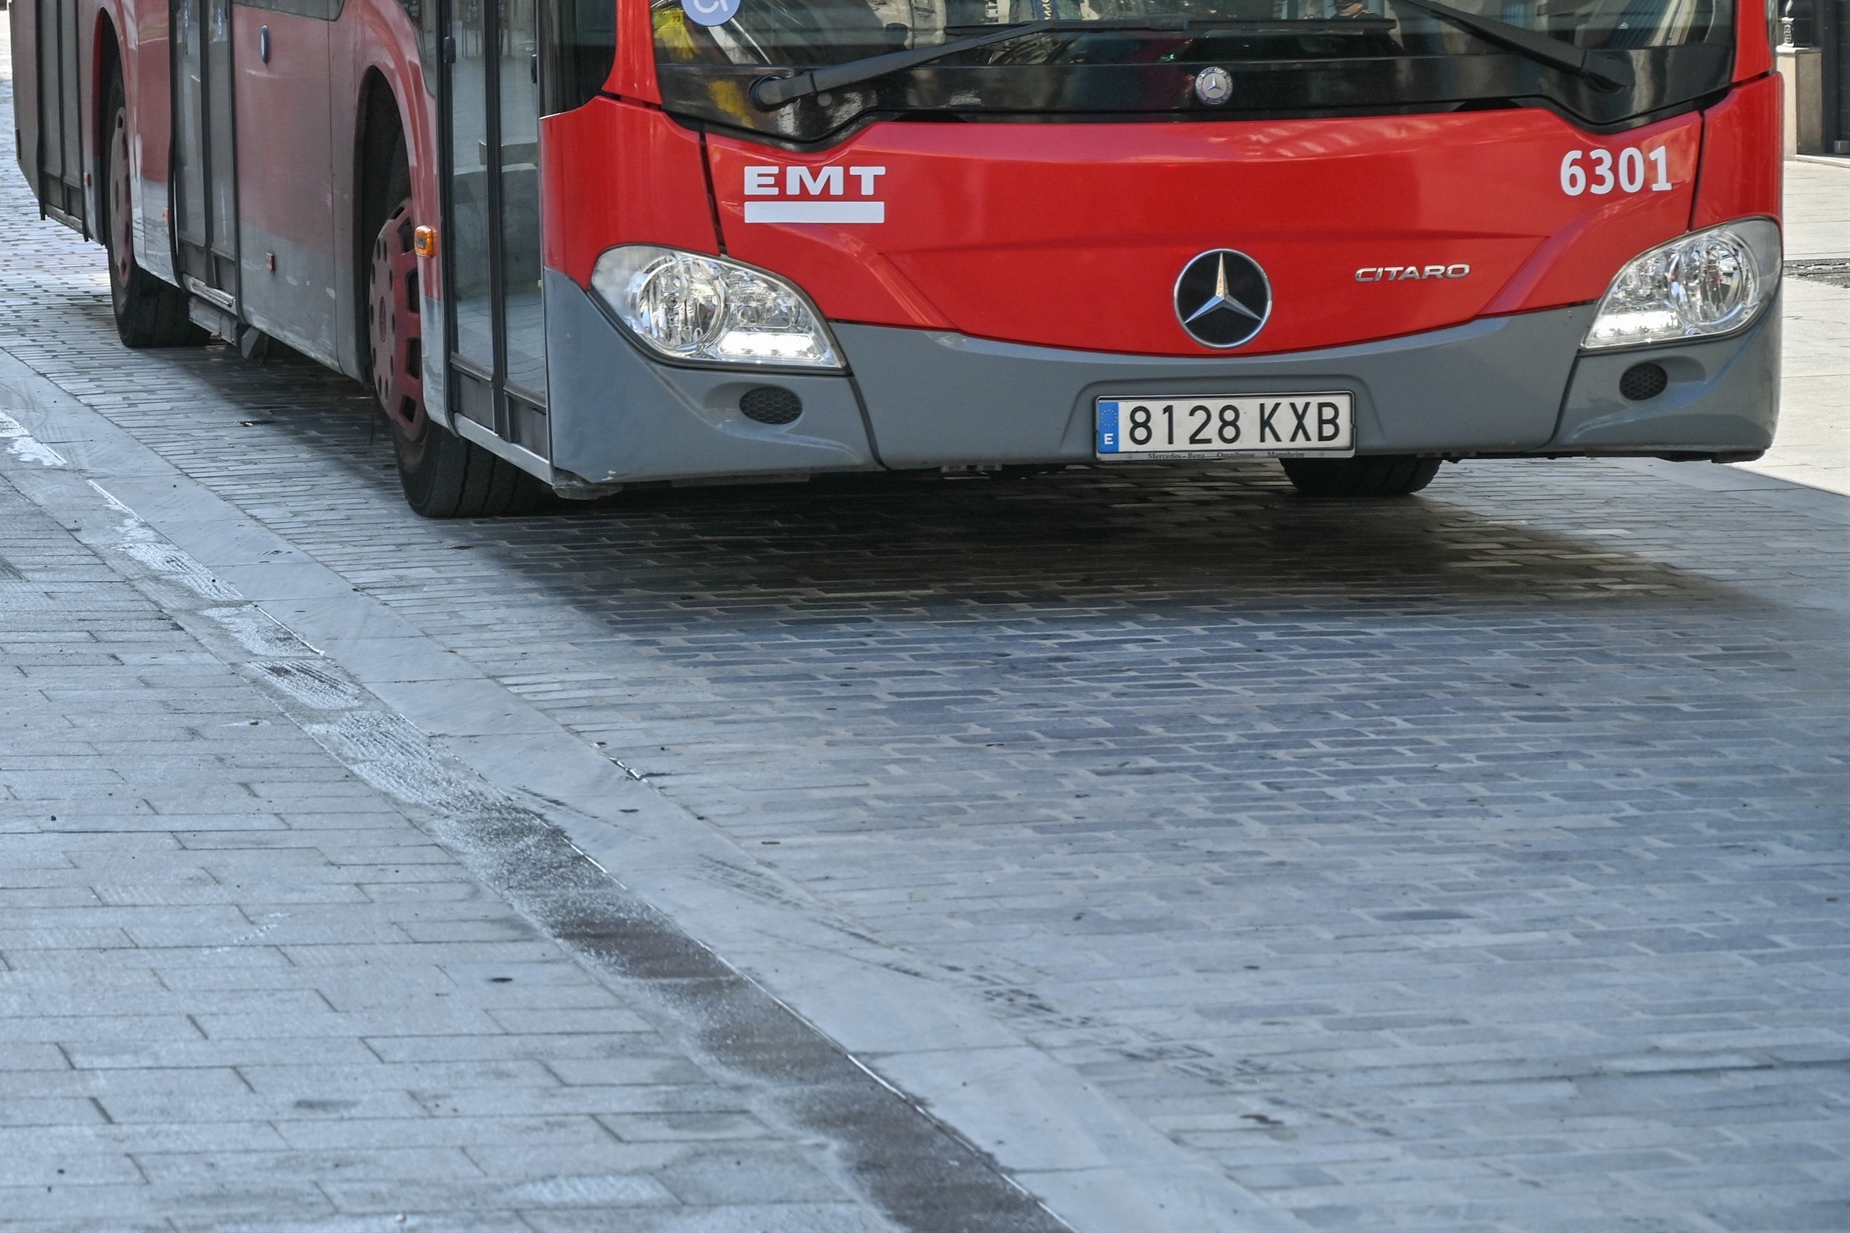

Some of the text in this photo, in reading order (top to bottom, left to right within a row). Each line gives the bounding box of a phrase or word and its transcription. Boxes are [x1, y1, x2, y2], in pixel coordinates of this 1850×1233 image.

[743, 165, 886, 196] EMT
[1560, 144, 1673, 197] 6301
[1354, 263, 1470, 282] CITARO
[1103, 401, 1341, 446] E 8128 KXB
